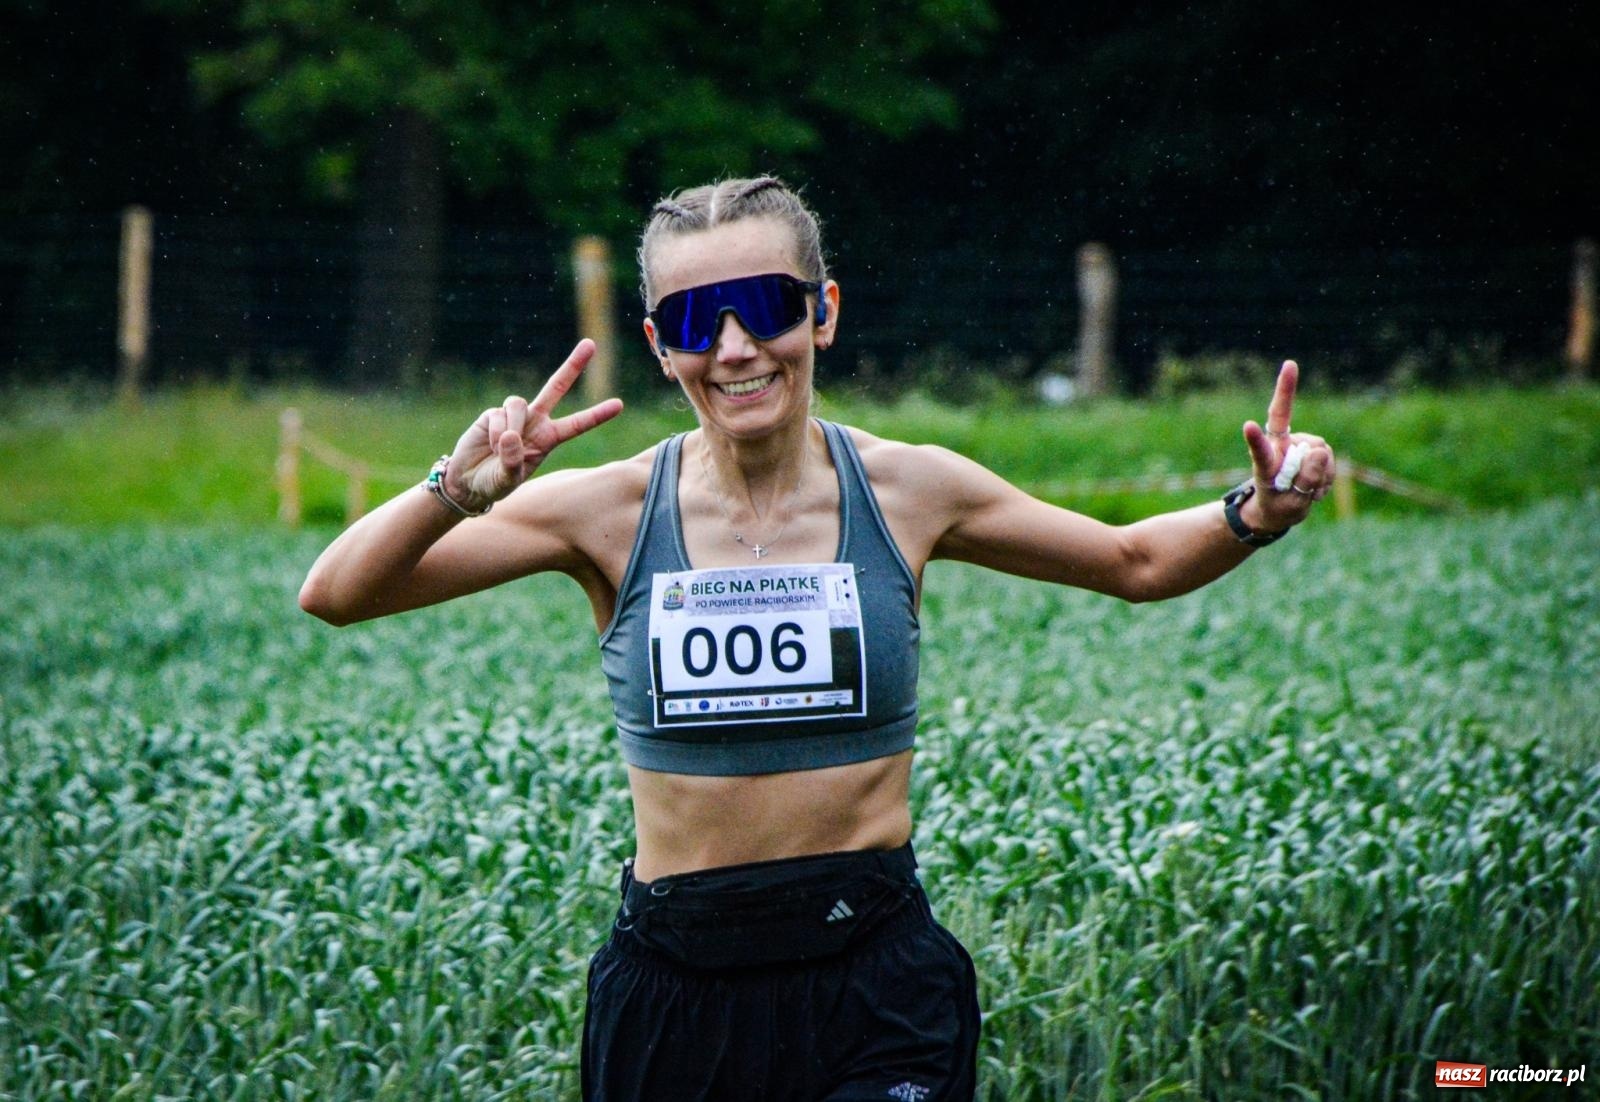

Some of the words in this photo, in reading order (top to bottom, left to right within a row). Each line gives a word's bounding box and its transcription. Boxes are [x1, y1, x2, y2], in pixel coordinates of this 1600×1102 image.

[691, 581, 726, 595] BIEG
[730, 579, 755, 593] NA
[760, 576, 820, 593] PIĄTKĘ
[695, 600, 708, 608] PO
[709, 597, 753, 608] POWIECIE
[754, 594, 815, 606] RACIBORSKIM
[682, 622, 807, 678] 006
